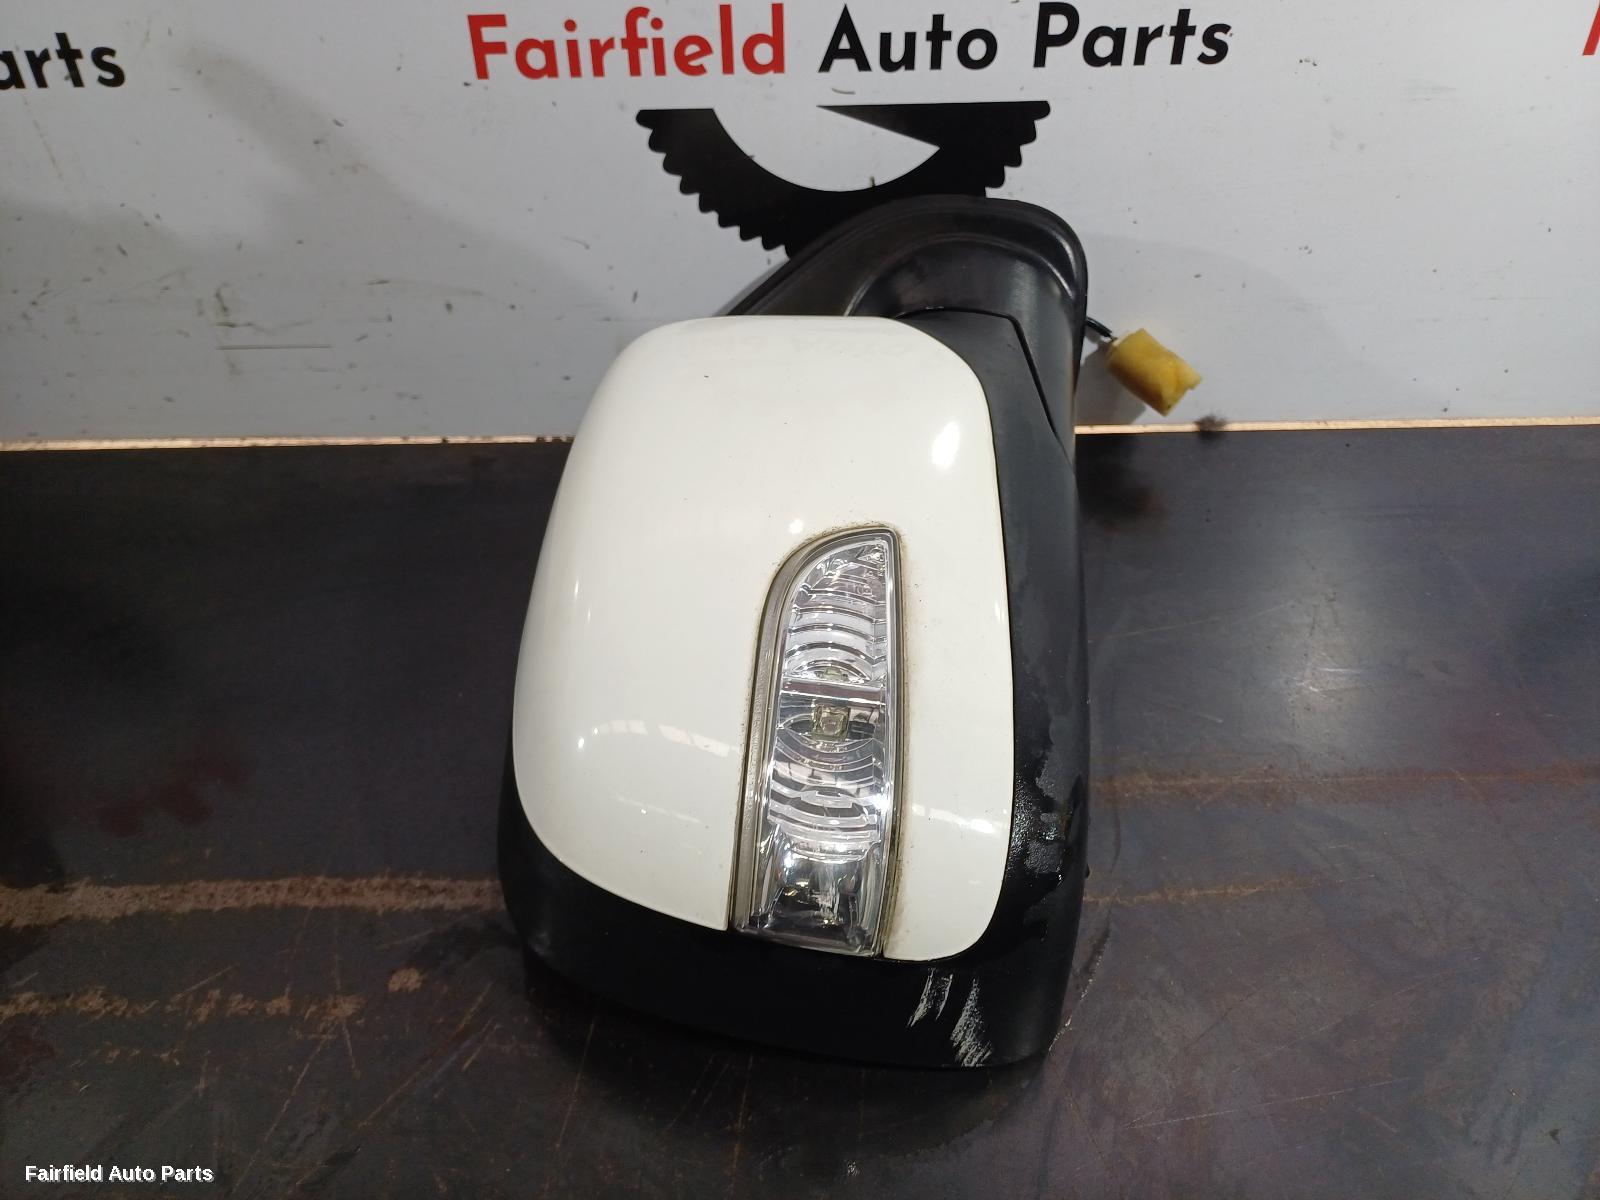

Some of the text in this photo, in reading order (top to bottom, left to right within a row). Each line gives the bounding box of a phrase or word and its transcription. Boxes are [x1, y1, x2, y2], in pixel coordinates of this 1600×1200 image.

[467, 2, 1232, 80] Fairfield Auto Parts
